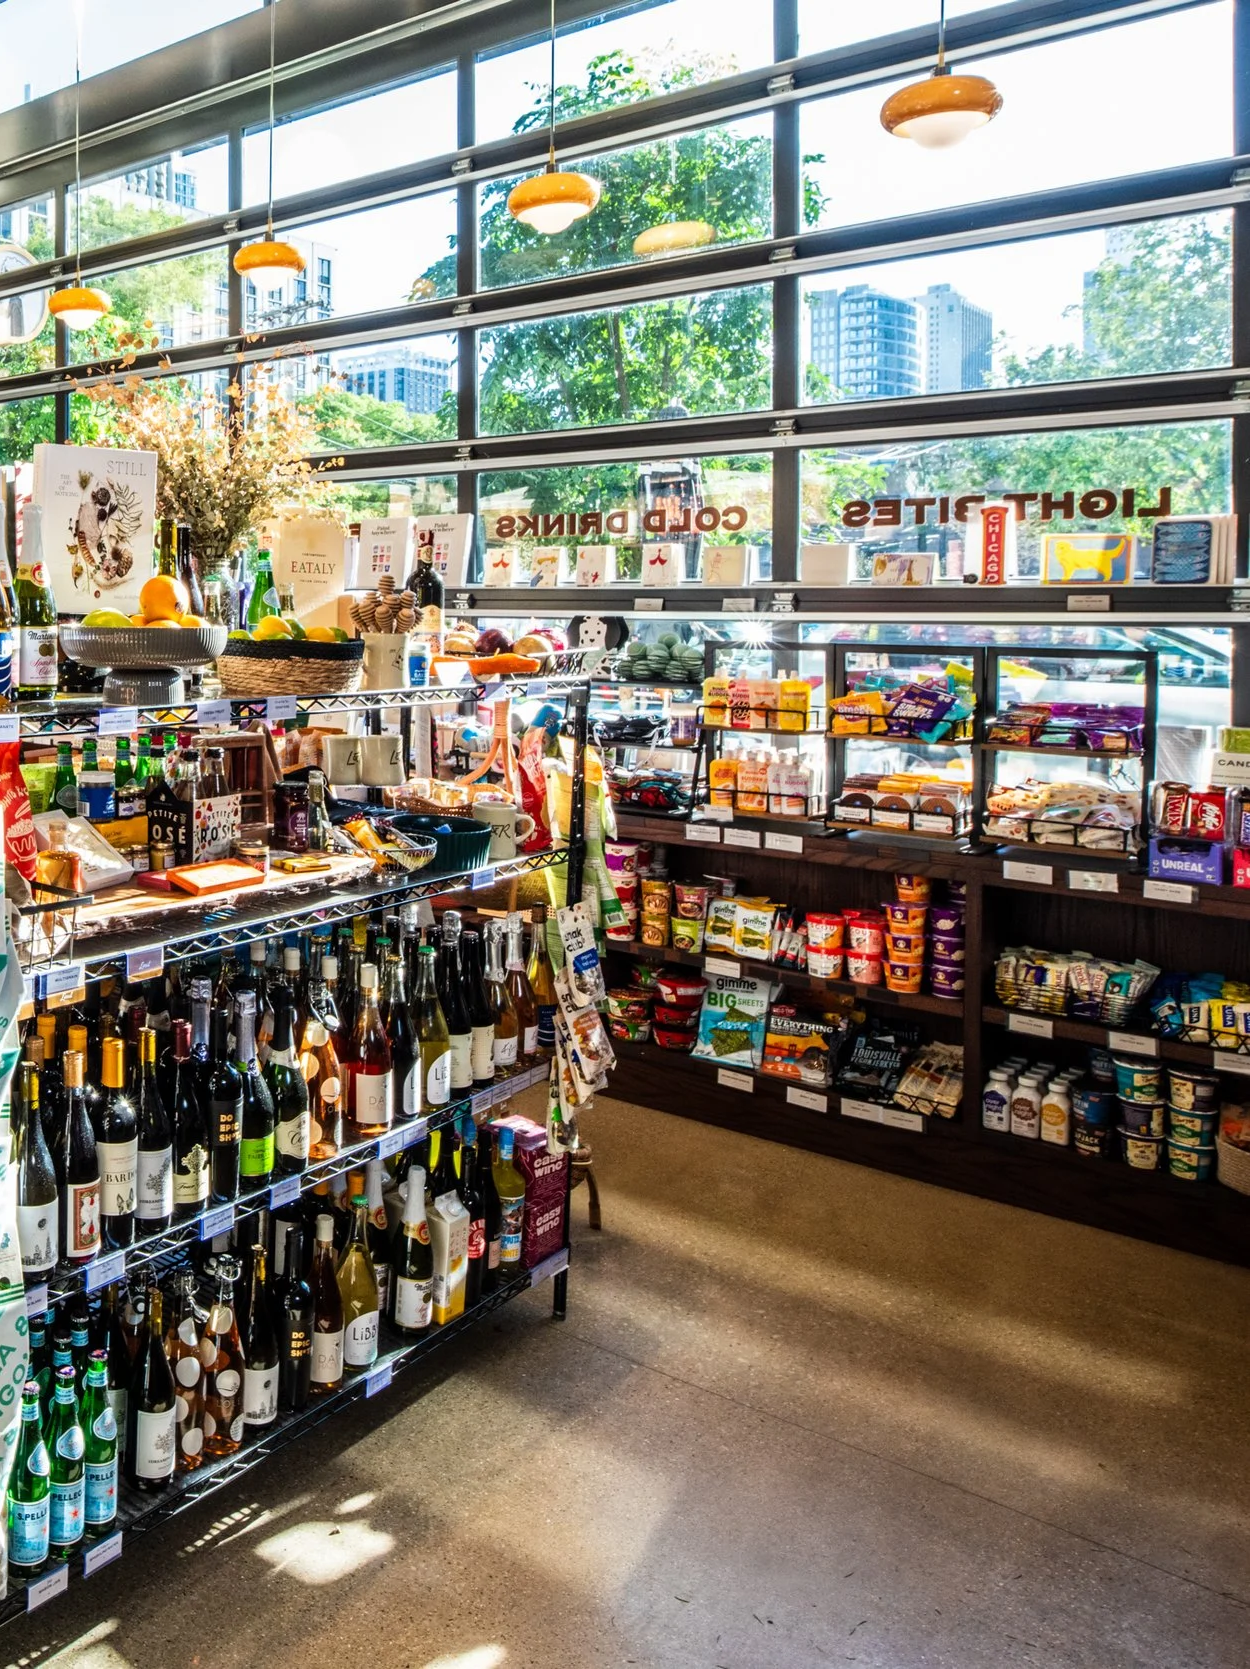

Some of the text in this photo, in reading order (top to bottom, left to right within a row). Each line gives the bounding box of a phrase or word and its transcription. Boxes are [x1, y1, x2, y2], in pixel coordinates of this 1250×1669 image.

[106, 459, 148, 478] STILL
[986, 513, 1001, 584] CHICAGO
[290, 560, 337, 576] EATALY
[147, 809, 179, 822] PETITE
[207, 810, 231, 821] PETITE
[1167, 794, 1183, 831] TWIX
[152, 824, 187, 844] OSÉ
[200, 822, 236, 844] ROSÉ
[1161, 858, 1204, 873] UNREAL
[714, 905, 736, 916] gimme
[742, 916, 768, 928] gimme
[716, 977, 758, 992] gimme
[706, 991, 765, 1010] BIG SHEETS
[1224, 1005, 1234, 1027] LUNA
[770, 1017, 834, 1035] EVERYTHING
[853, 1047, 902, 1063] LOUISVILLE
[220, 1113, 234, 1122] DO
[219, 1122, 240, 1132] EPIC
[534, 1163, 563, 1179] wine
[536, 1206, 561, 1227] easy
[536, 1217, 560, 1237] wine
[291, 1331, 305, 1340] DO
[352, 1325, 377, 1342] LiBB
[290, 1340, 310, 1349] EPIC
